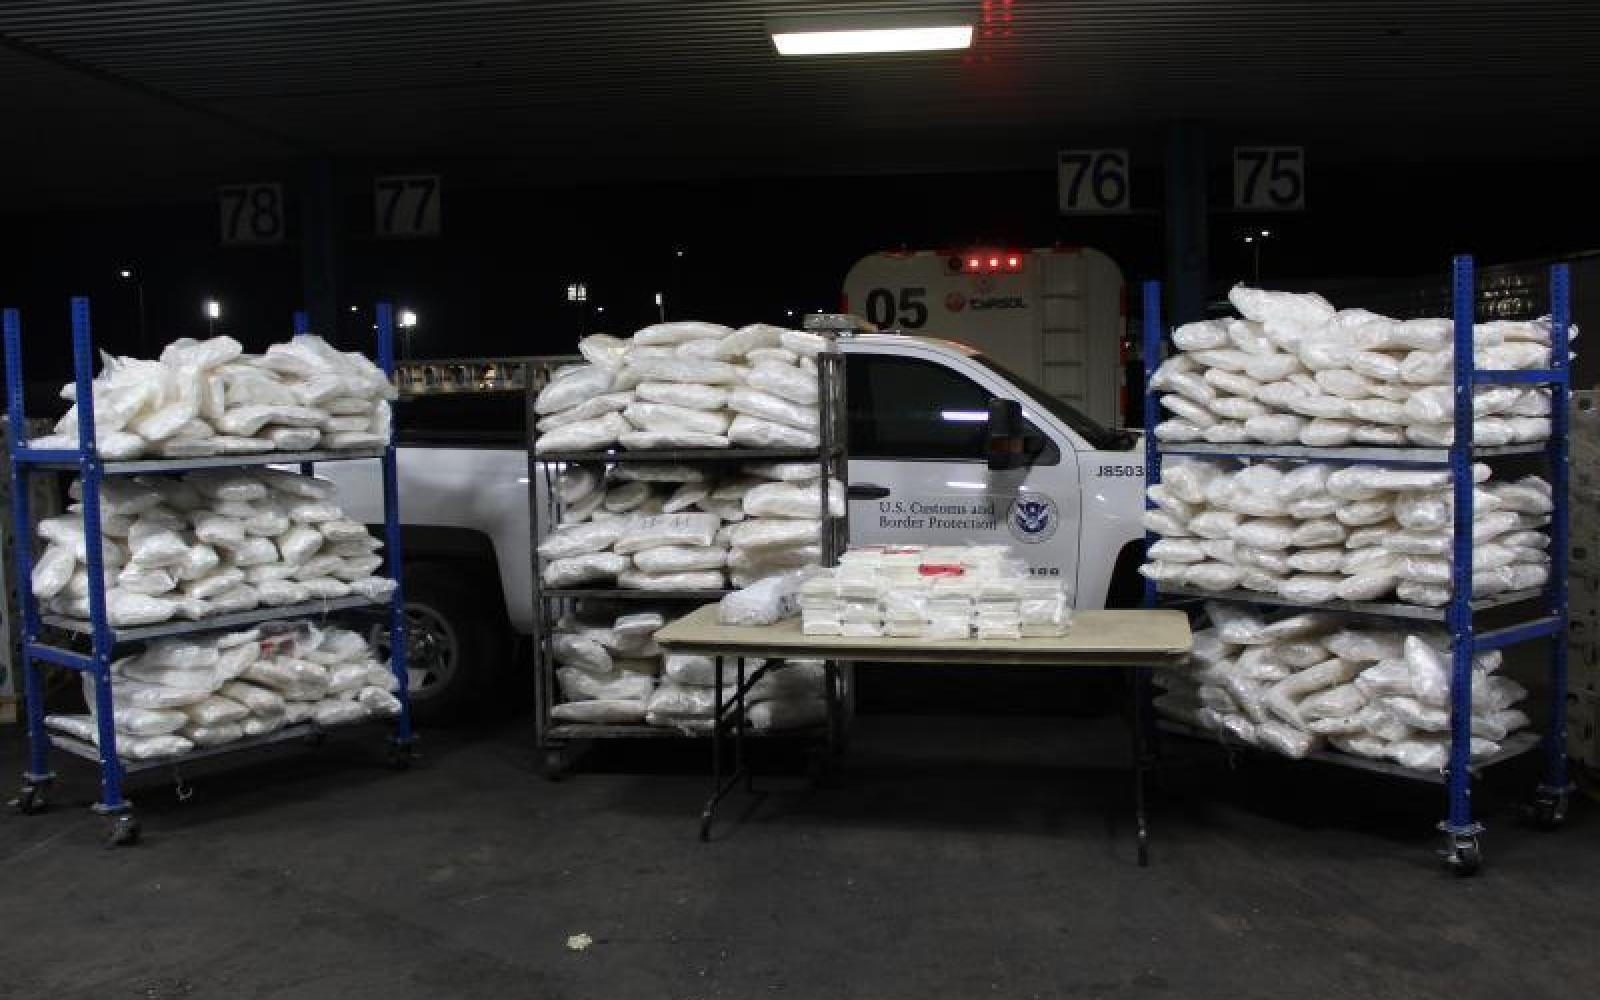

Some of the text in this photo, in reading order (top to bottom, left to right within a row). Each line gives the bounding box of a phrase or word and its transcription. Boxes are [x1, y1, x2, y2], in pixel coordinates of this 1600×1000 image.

[1061, 153, 1125, 208] 76
[1236, 151, 1300, 205] 75
[223, 187, 279, 238] 78
[377, 179, 435, 231] 77
[866, 287, 928, 329] 05
[879, 501, 995, 514] U.S. Customs and
[879, 515, 997, 530] Border Protection
